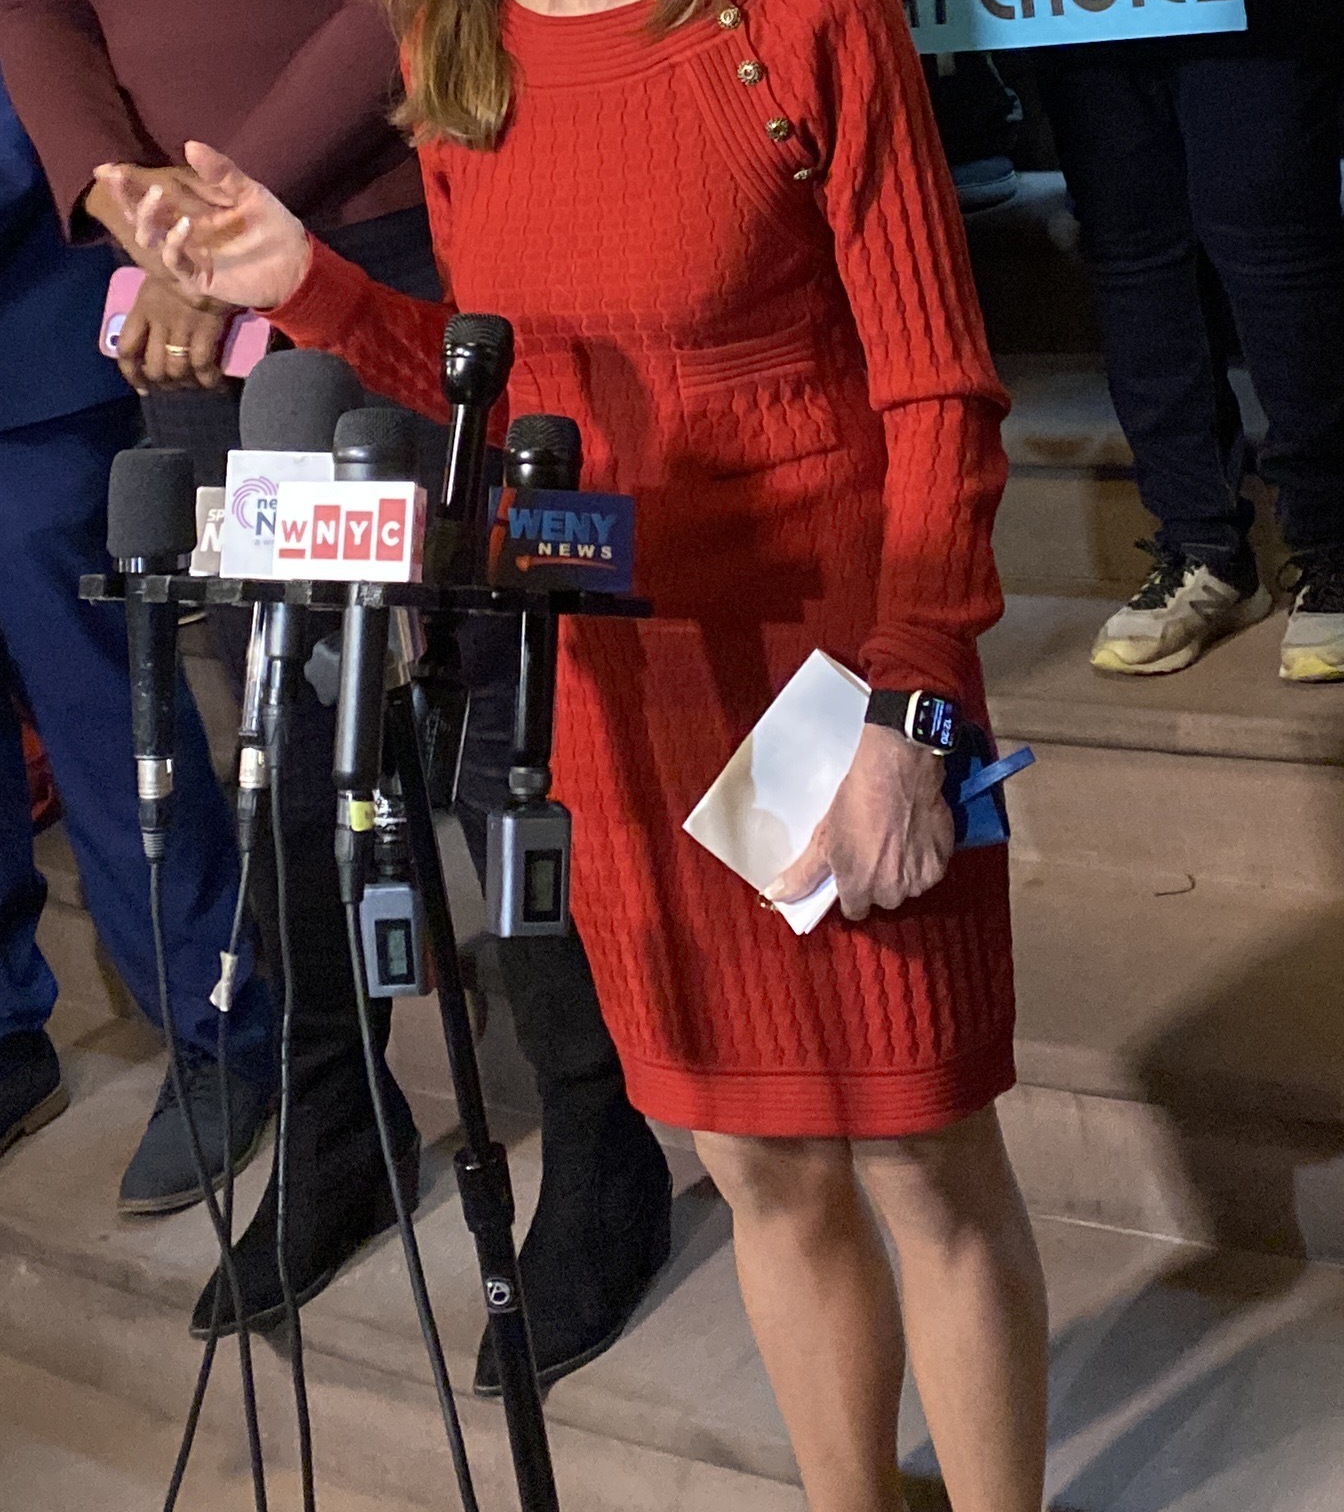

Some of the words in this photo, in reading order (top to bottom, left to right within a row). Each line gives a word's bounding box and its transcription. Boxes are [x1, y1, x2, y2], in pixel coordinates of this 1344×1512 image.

[281, 519, 402, 547] WNYC
[507, 507, 618, 544] WENY
[538, 541, 613, 560] NEWS
